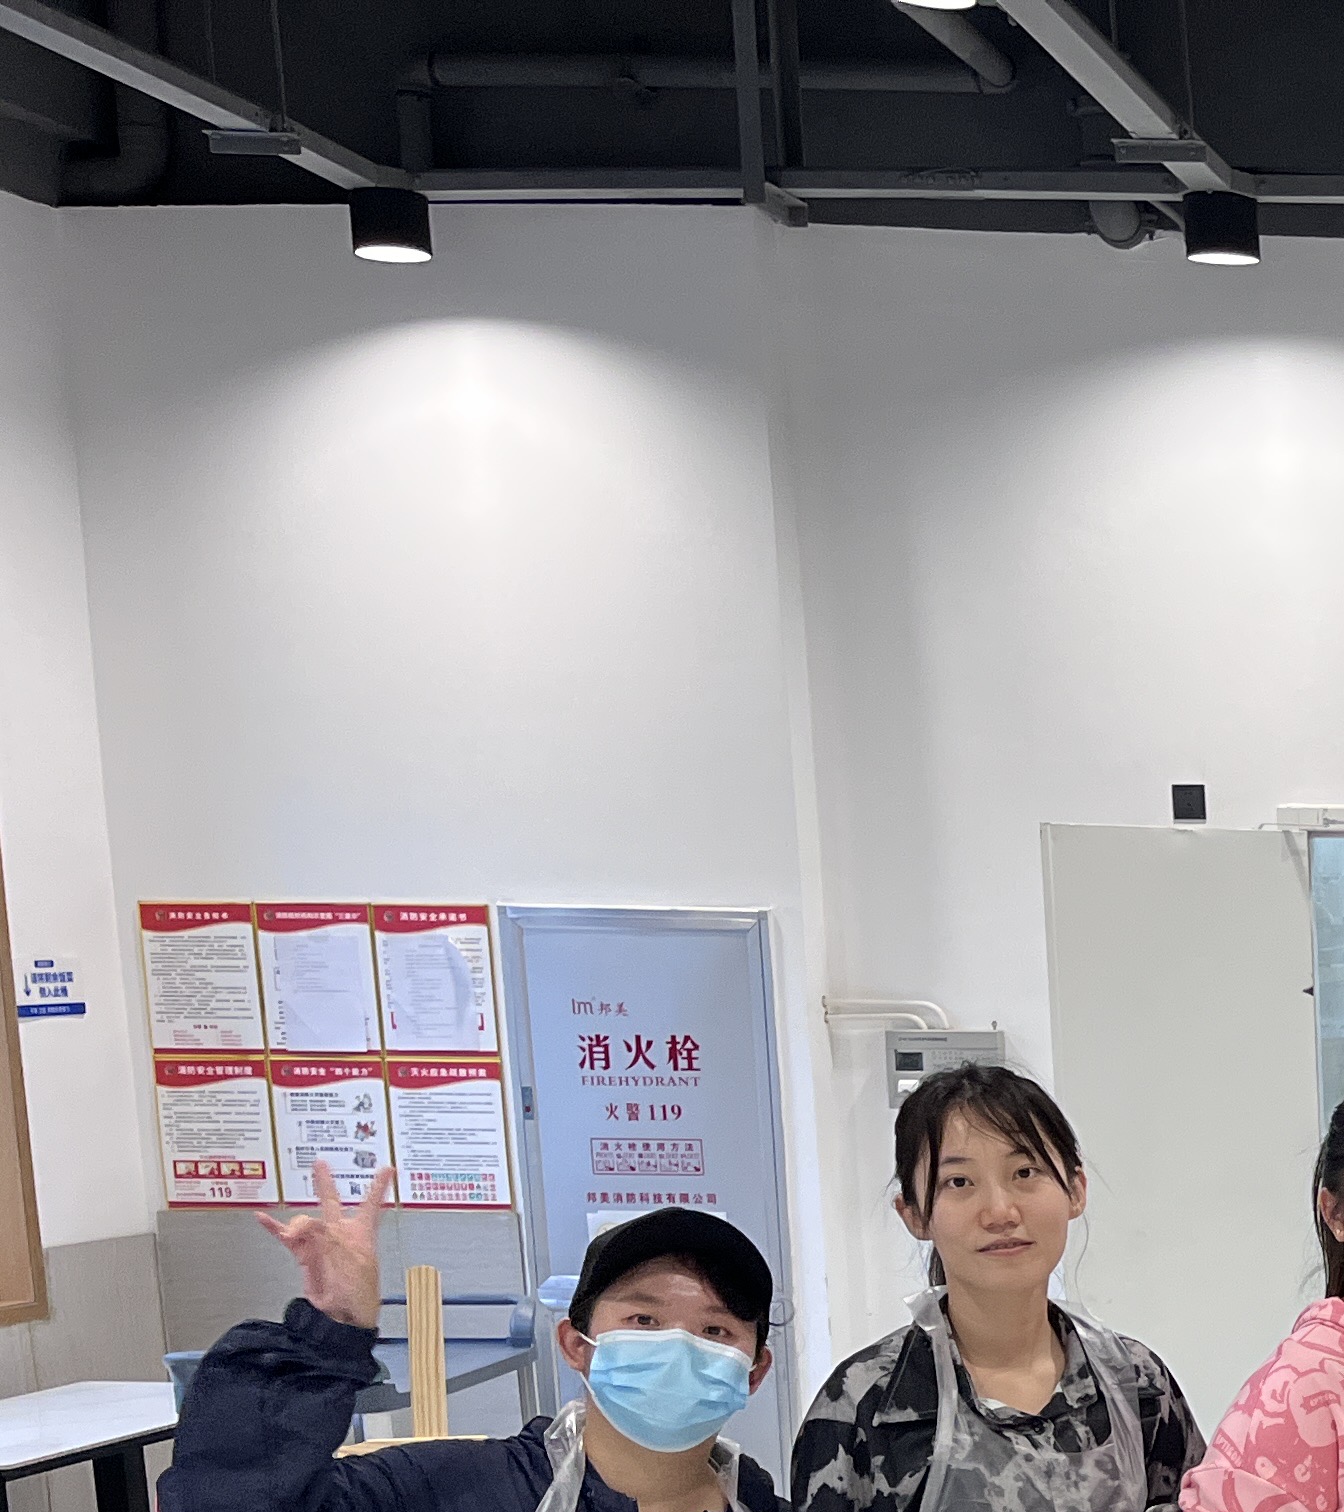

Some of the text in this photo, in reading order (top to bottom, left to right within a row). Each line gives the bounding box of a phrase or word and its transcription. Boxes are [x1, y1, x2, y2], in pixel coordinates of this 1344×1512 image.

[599, 1002, 628, 1016] 邦美
[578, 1034, 701, 1072] 消火栓
[582, 1075, 700, 1087] FIREHYDRANT
[600, 1142, 694, 1151] 消火栓使用方法
[209, 1186, 232, 1198] 119
[587, 1192, 717, 1204] 邦美消防科技有限公司
